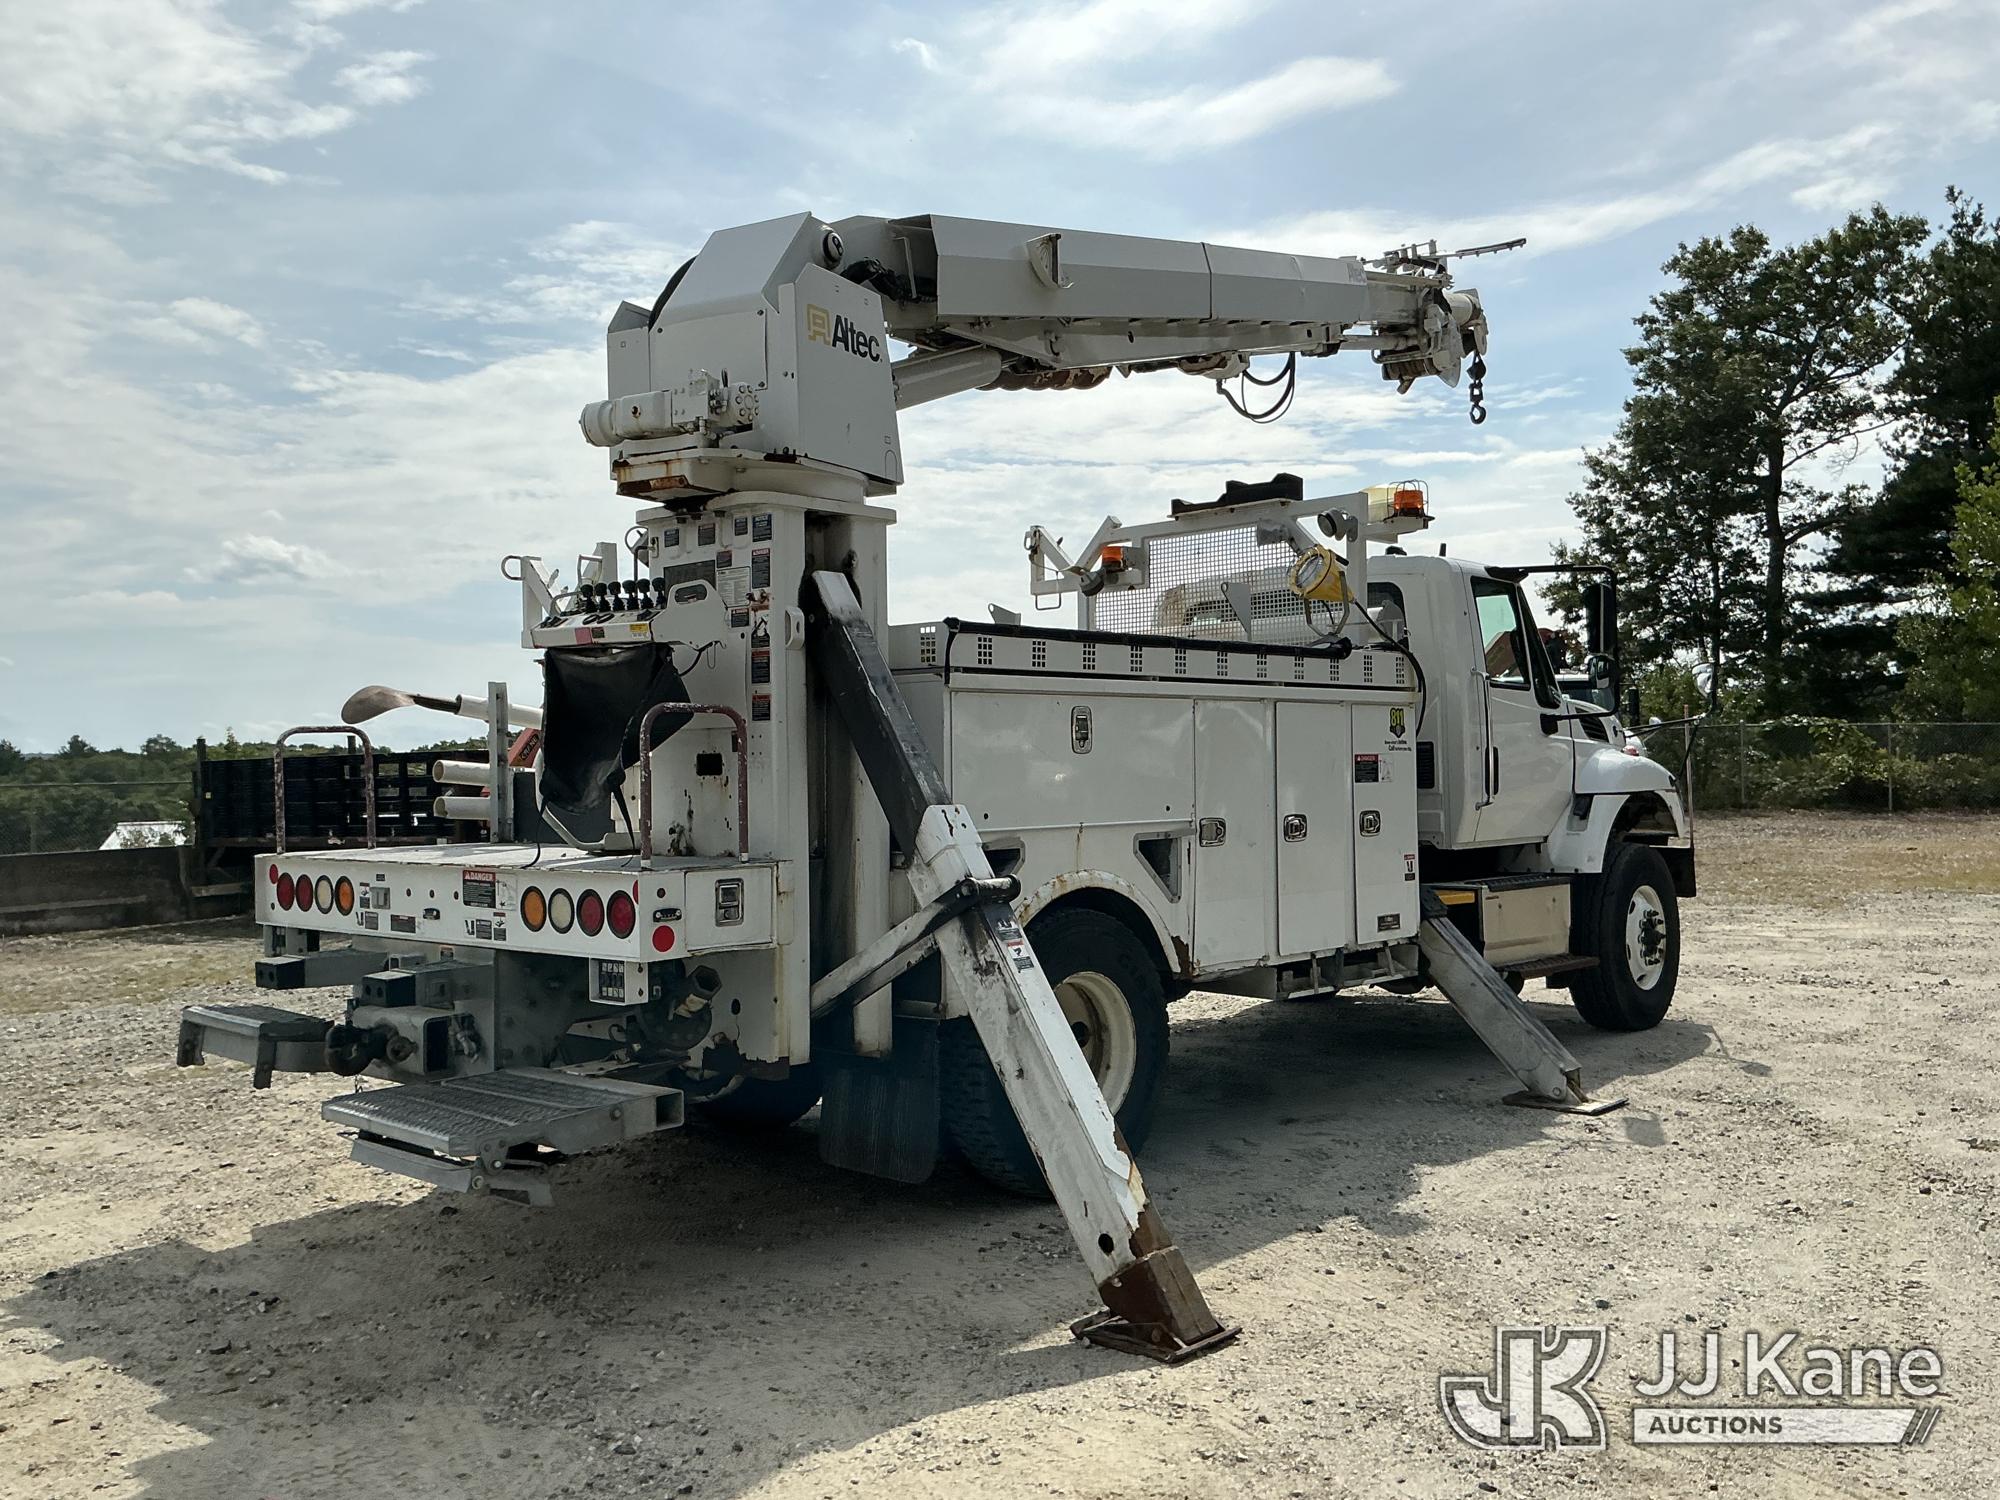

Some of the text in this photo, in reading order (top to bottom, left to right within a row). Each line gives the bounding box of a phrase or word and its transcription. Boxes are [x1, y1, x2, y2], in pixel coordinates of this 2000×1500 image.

[832, 314, 880, 362] Altec
[1391, 709, 1404, 727] 811
[471, 872, 494, 882] DANGER
